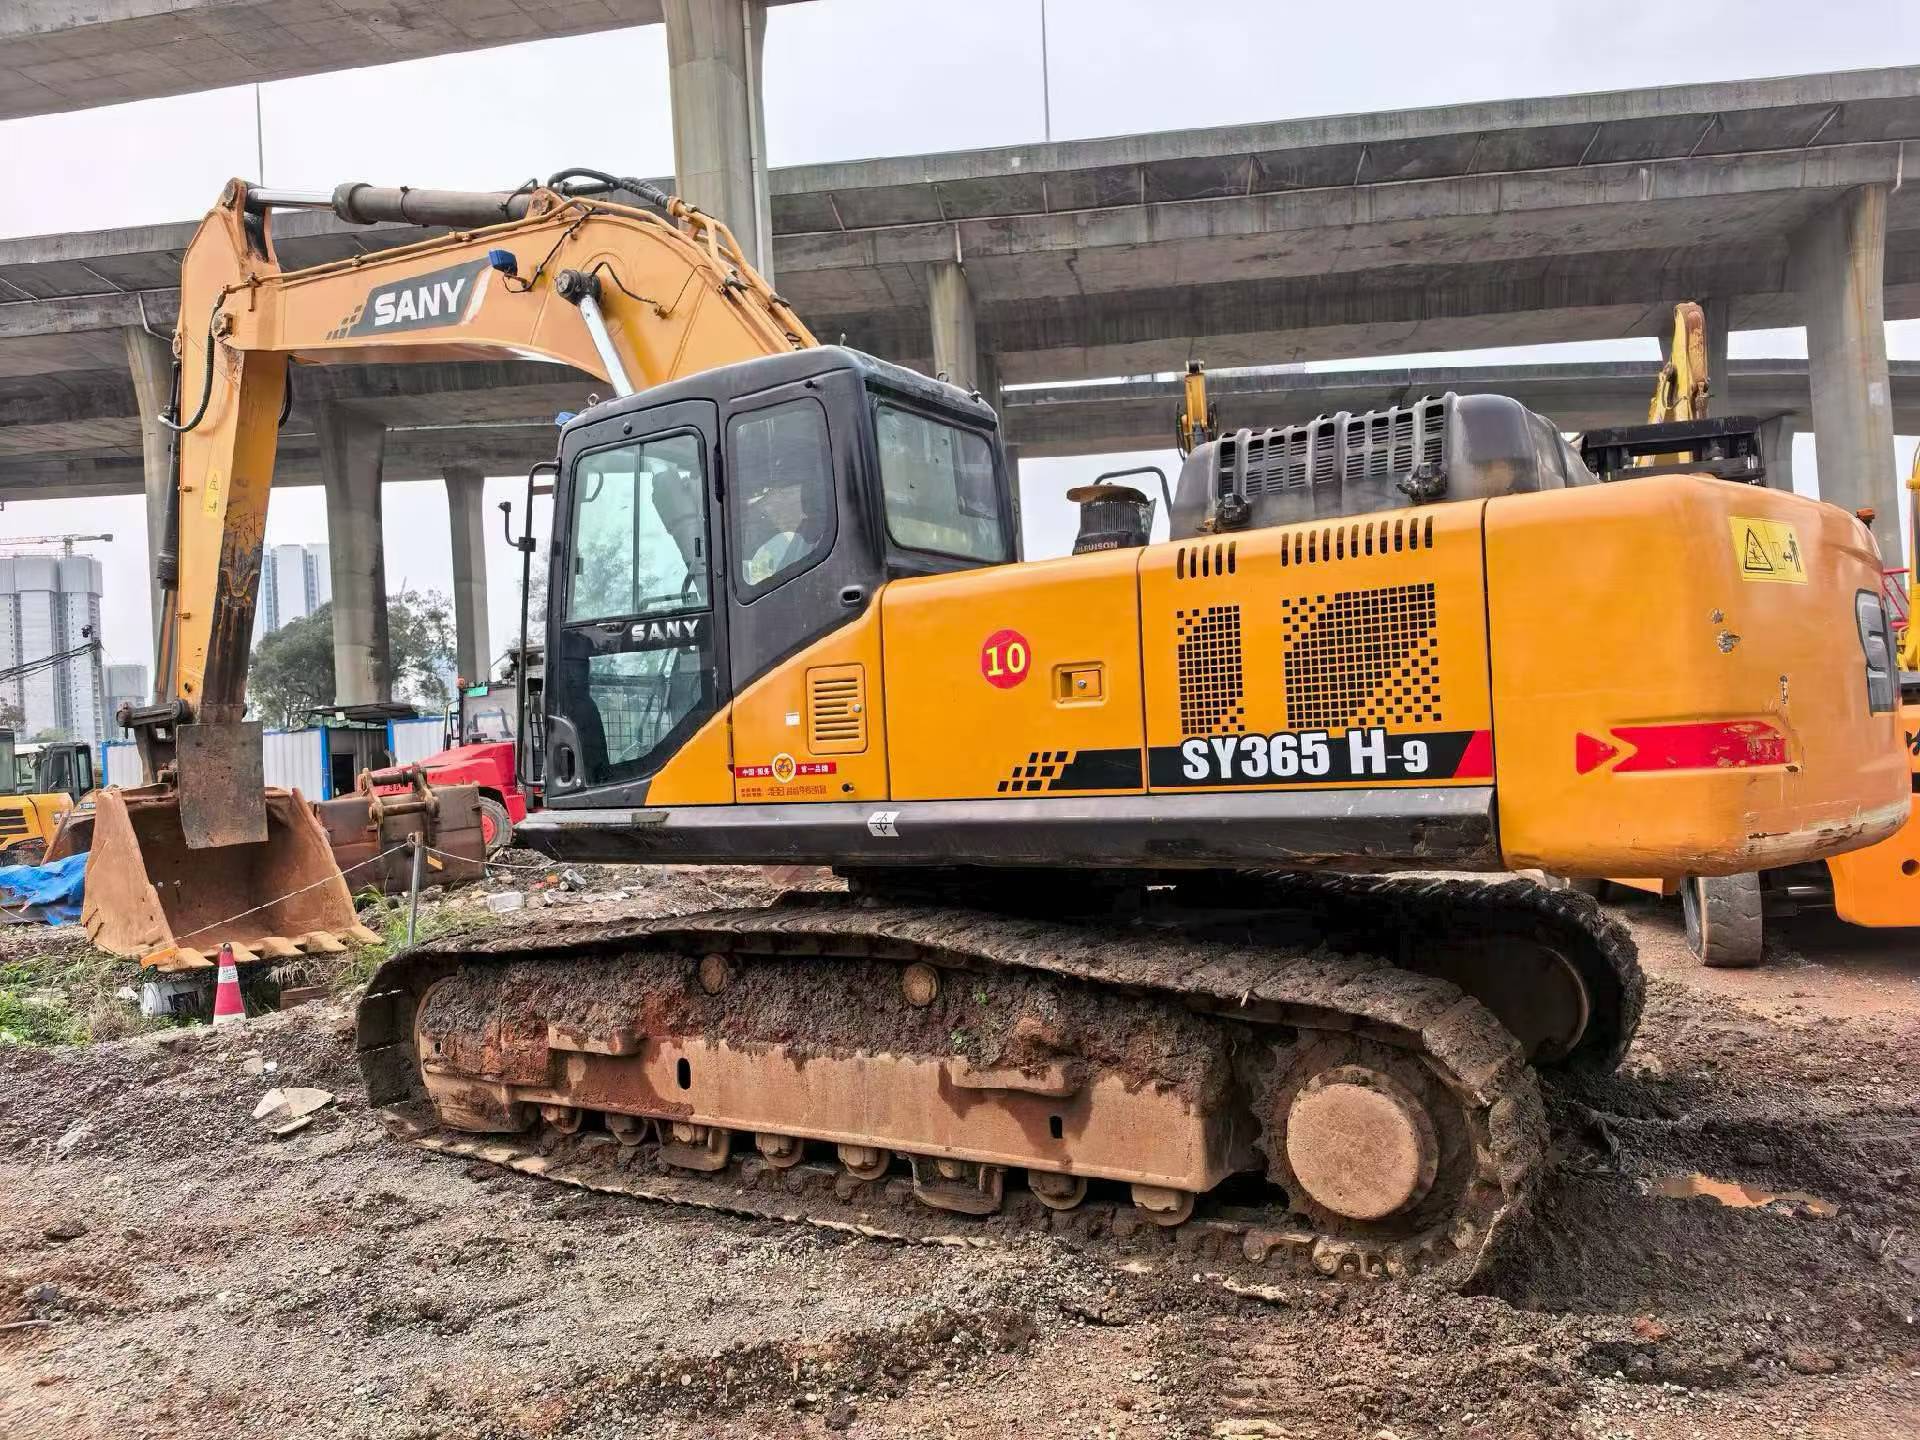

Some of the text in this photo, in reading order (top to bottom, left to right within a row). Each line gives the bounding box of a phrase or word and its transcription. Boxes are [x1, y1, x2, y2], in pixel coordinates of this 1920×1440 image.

[374, 278, 466, 327] SANY
[631, 619, 700, 641] SANY
[985, 642, 1026, 677] 10
[1181, 732, 1331, 780] SY365
